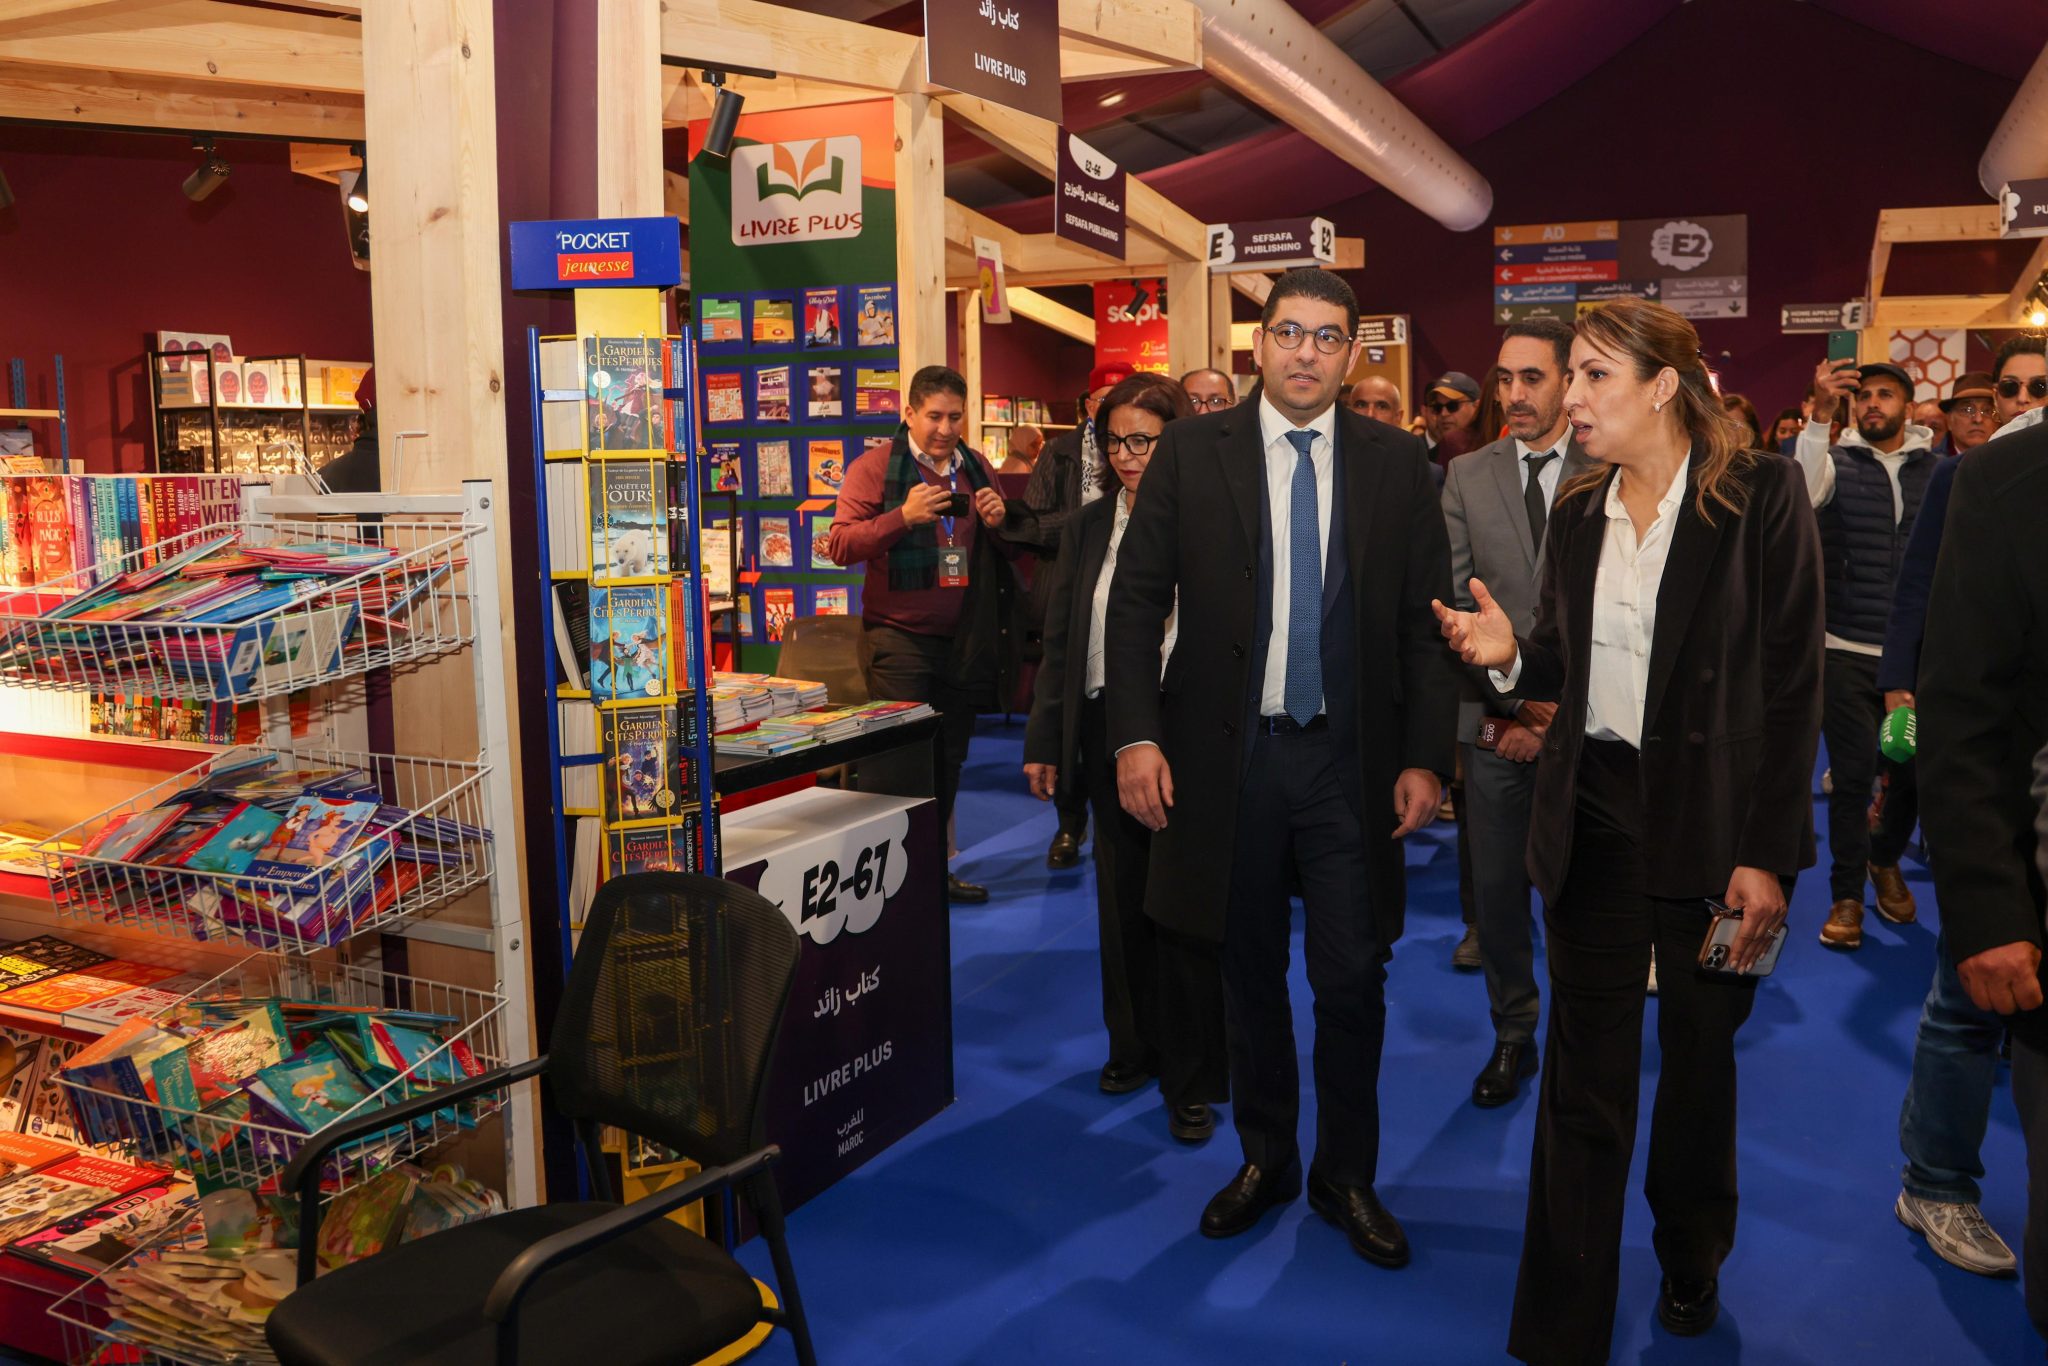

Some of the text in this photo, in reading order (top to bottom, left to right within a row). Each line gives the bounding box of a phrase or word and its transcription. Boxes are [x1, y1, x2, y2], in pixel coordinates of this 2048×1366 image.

[998, 8, 1019, 30] كتاب
[974, 52, 1027, 86] LIVRE PLUS
[1085, 159, 1101, 177] E2-66
[740, 212, 863, 239] LIVRE PLUS
[1065, 213, 1119, 242] SEFSAFA PUBLISHING
[1252, 232, 1293, 243] SEFSAFA
[1543, 226, 1565, 240] AD
[561, 232, 630, 250] POCKET
[1209, 232, 1224, 260] E
[1244, 242, 1301, 255] PUBLISHING
[1671, 233, 1707, 258] E2
[563, 258, 630, 277] jeunesse
[1850, 305, 1861, 324] E
[201, 479, 216, 500] IT
[614, 482, 639, 490] QUÊTE
[138, 483, 150, 525] SLAMMED
[154, 482, 165, 524] HOPELESS
[166, 482, 177, 523] HOPELESS
[176, 489, 185, 516] HOOVER
[188, 488, 196, 516] HOOVER
[36, 510, 61, 523] RULES
[40, 529, 63, 541] MAGIC
[800, 838, 891, 925] E2-67
[814, 964, 881, 1018] كتاب زائد
[804, 1040, 893, 1106] LIVRE PLUS
[837, 1108, 864, 1137] المغرب
[838, 1130, 864, 1158] MAROC
[57, 1169, 126, 1189] EARTHQUAKE
[75, 1165, 122, 1180] VOLCANO
